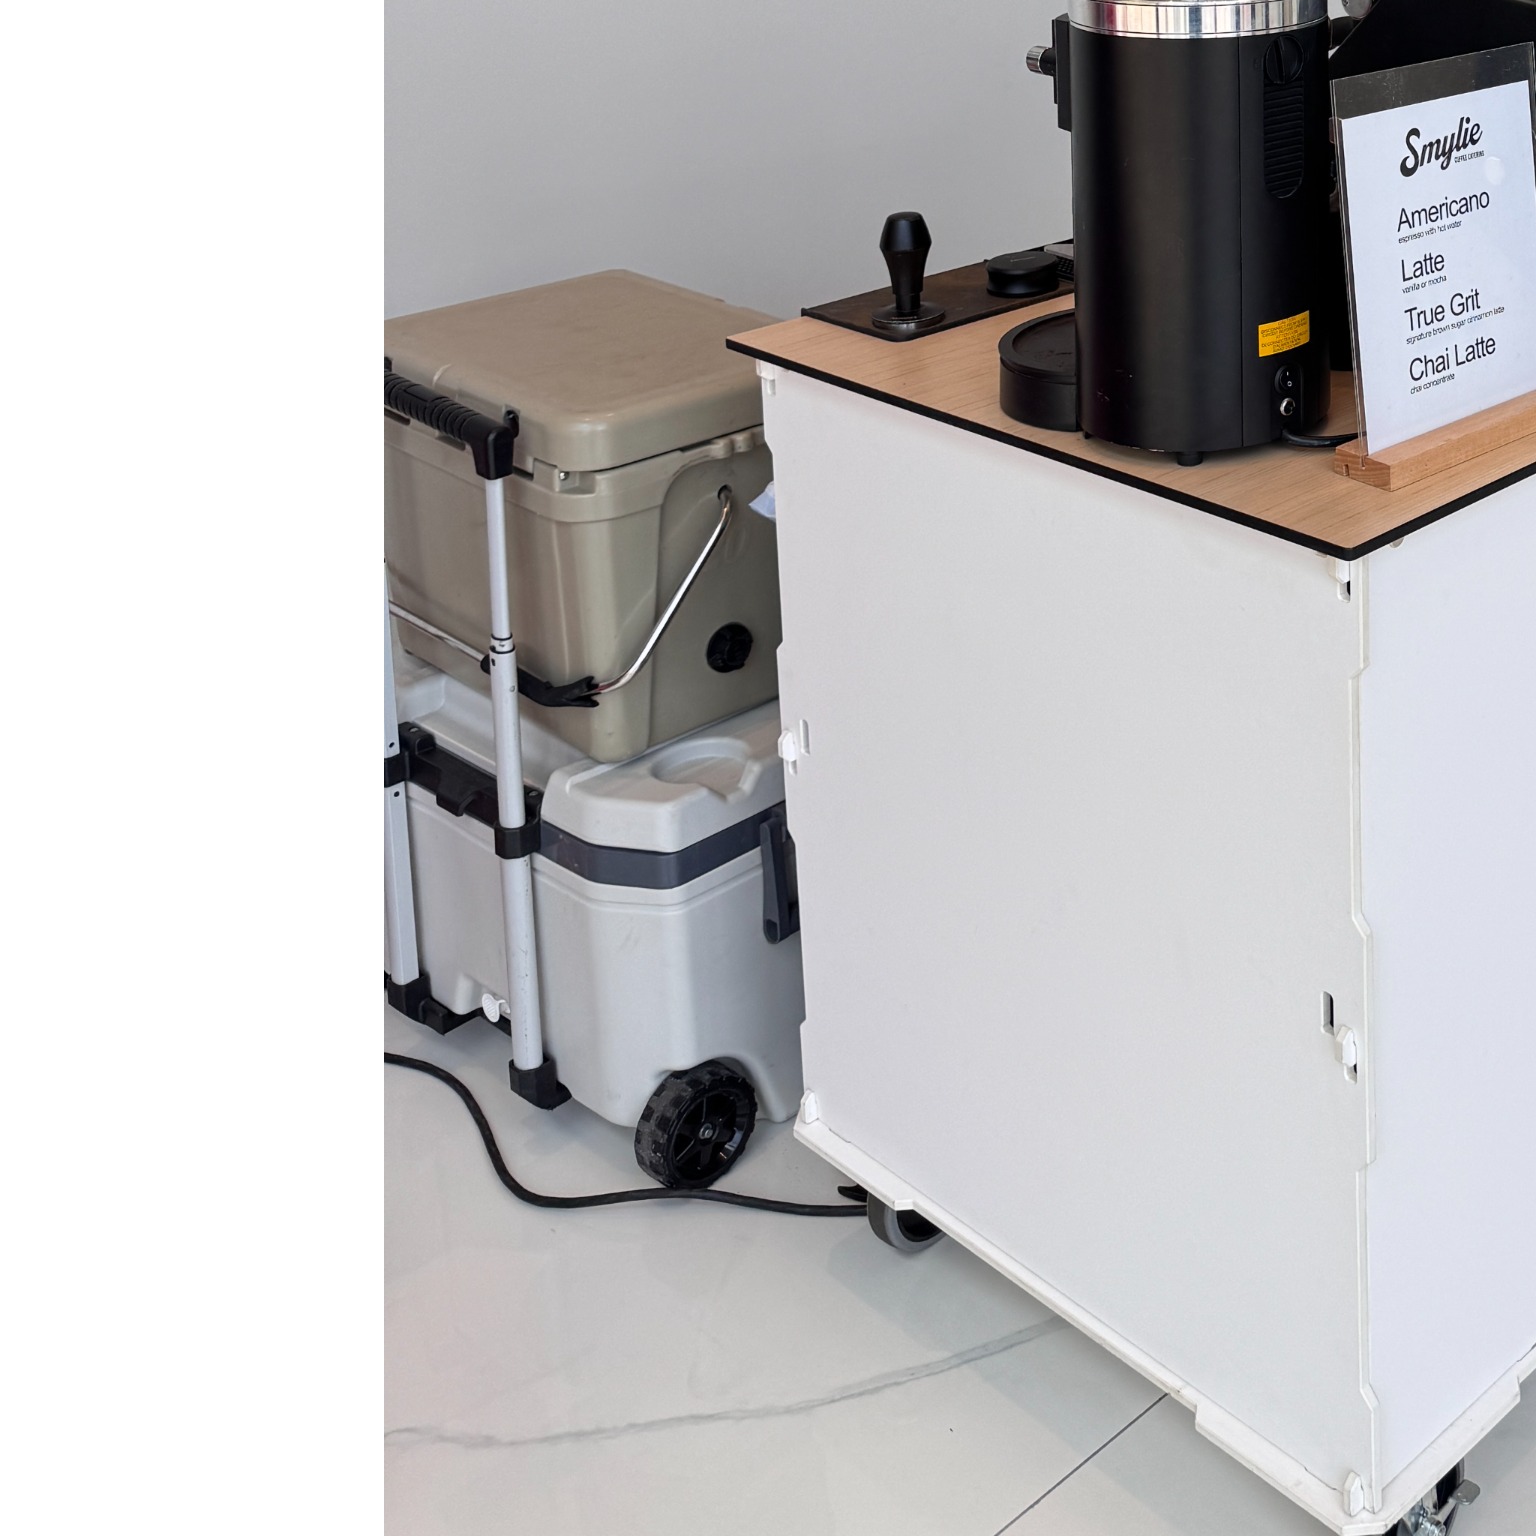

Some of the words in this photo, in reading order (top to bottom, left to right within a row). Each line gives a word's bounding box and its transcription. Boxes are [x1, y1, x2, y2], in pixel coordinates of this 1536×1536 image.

[1400, 116, 1483, 177] Smylie
[1397, 191, 1490, 232] Americano
[1398, 231, 1424, 244] espresso
[1425, 227, 1436, 236] with
[1437, 224, 1446, 232] hot
[1447, 220, 1462, 230] water
[1401, 252, 1445, 282] Latte
[1401, 283, 1420, 294] vanilla
[1428, 275, 1447, 286] mocha
[1404, 304, 1445, 331] True
[1450, 288, 1481, 316] Grit
[1406, 330, 1432, 344] signature
[1432, 325, 1450, 336] brown
[1451, 319, 1466, 329] sugar
[1467, 310, 1493, 323] cinnamon
[1493, 306, 1505, 315] latte
[1409, 347, 1450, 381] Chai
[1454, 336, 1496, 366] Latte
[1410, 385, 1422, 395] chai
[1423, 373, 1455, 390] concentrate
